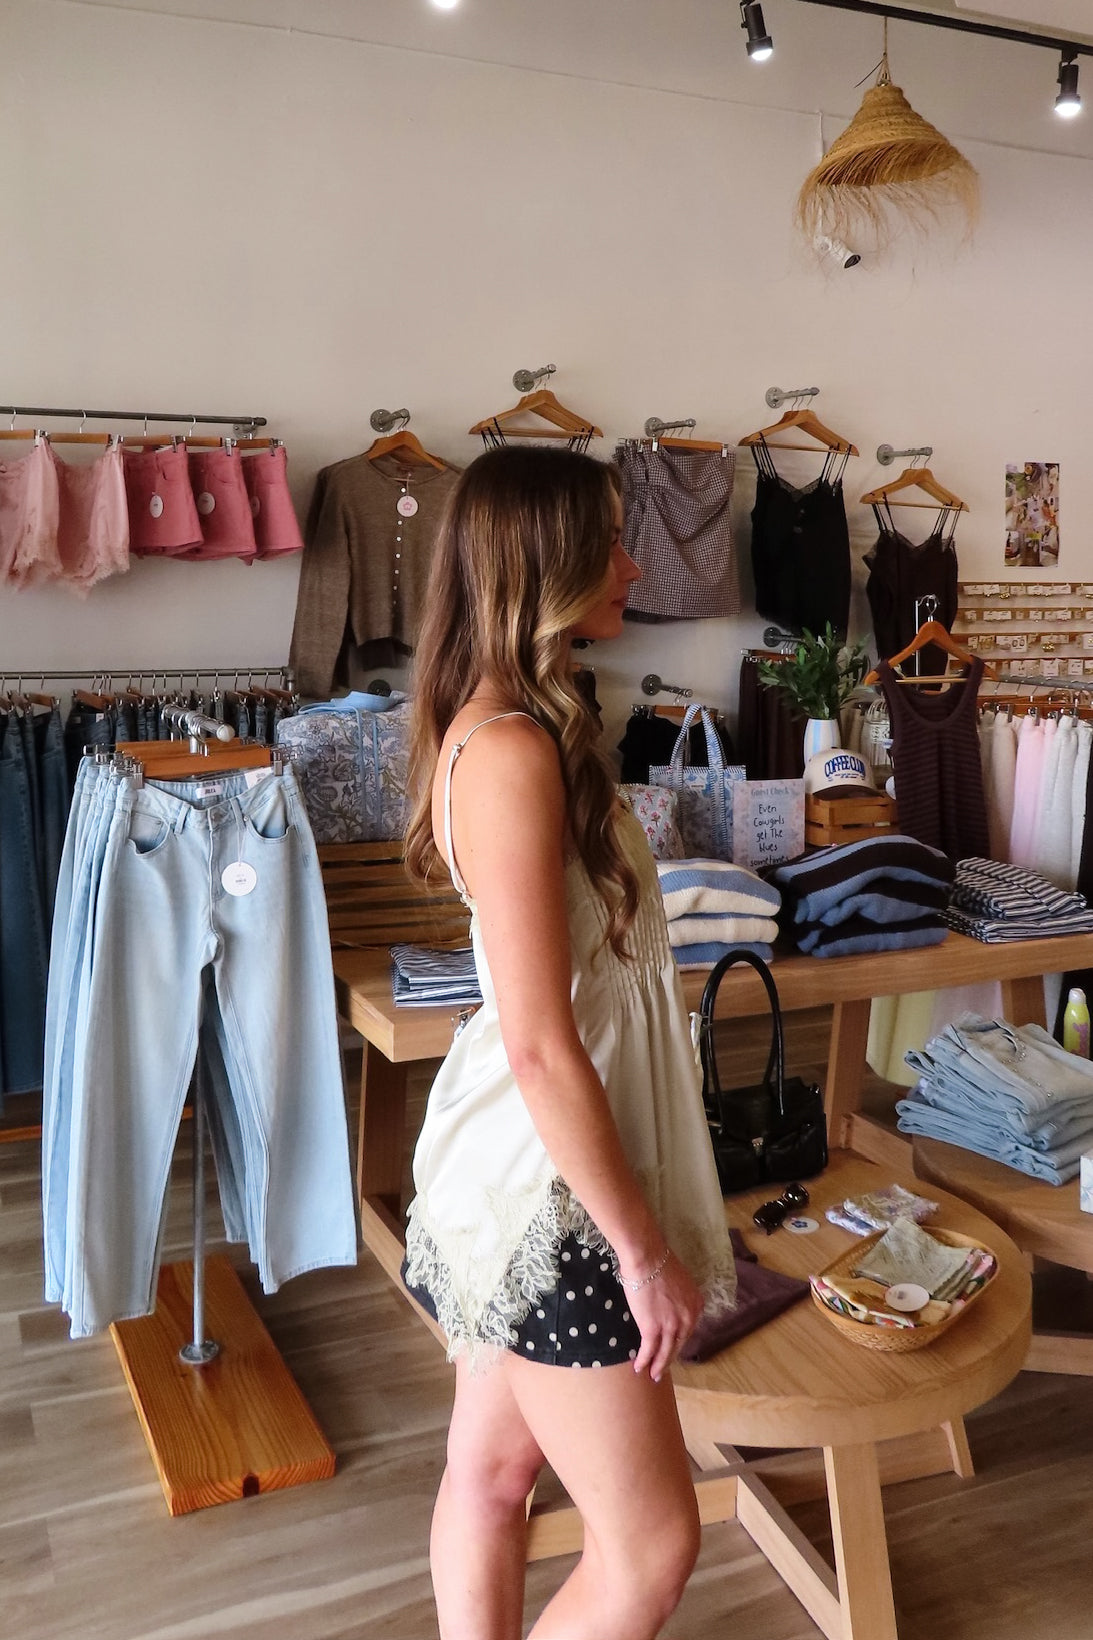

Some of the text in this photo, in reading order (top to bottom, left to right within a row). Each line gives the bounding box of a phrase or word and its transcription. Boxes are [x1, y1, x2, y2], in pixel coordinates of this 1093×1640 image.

[824, 755, 850, 777] COFFEE
[758, 803, 777, 814] Even
[753, 815, 784, 828] Cowgirls
[756, 829, 767, 842] get
